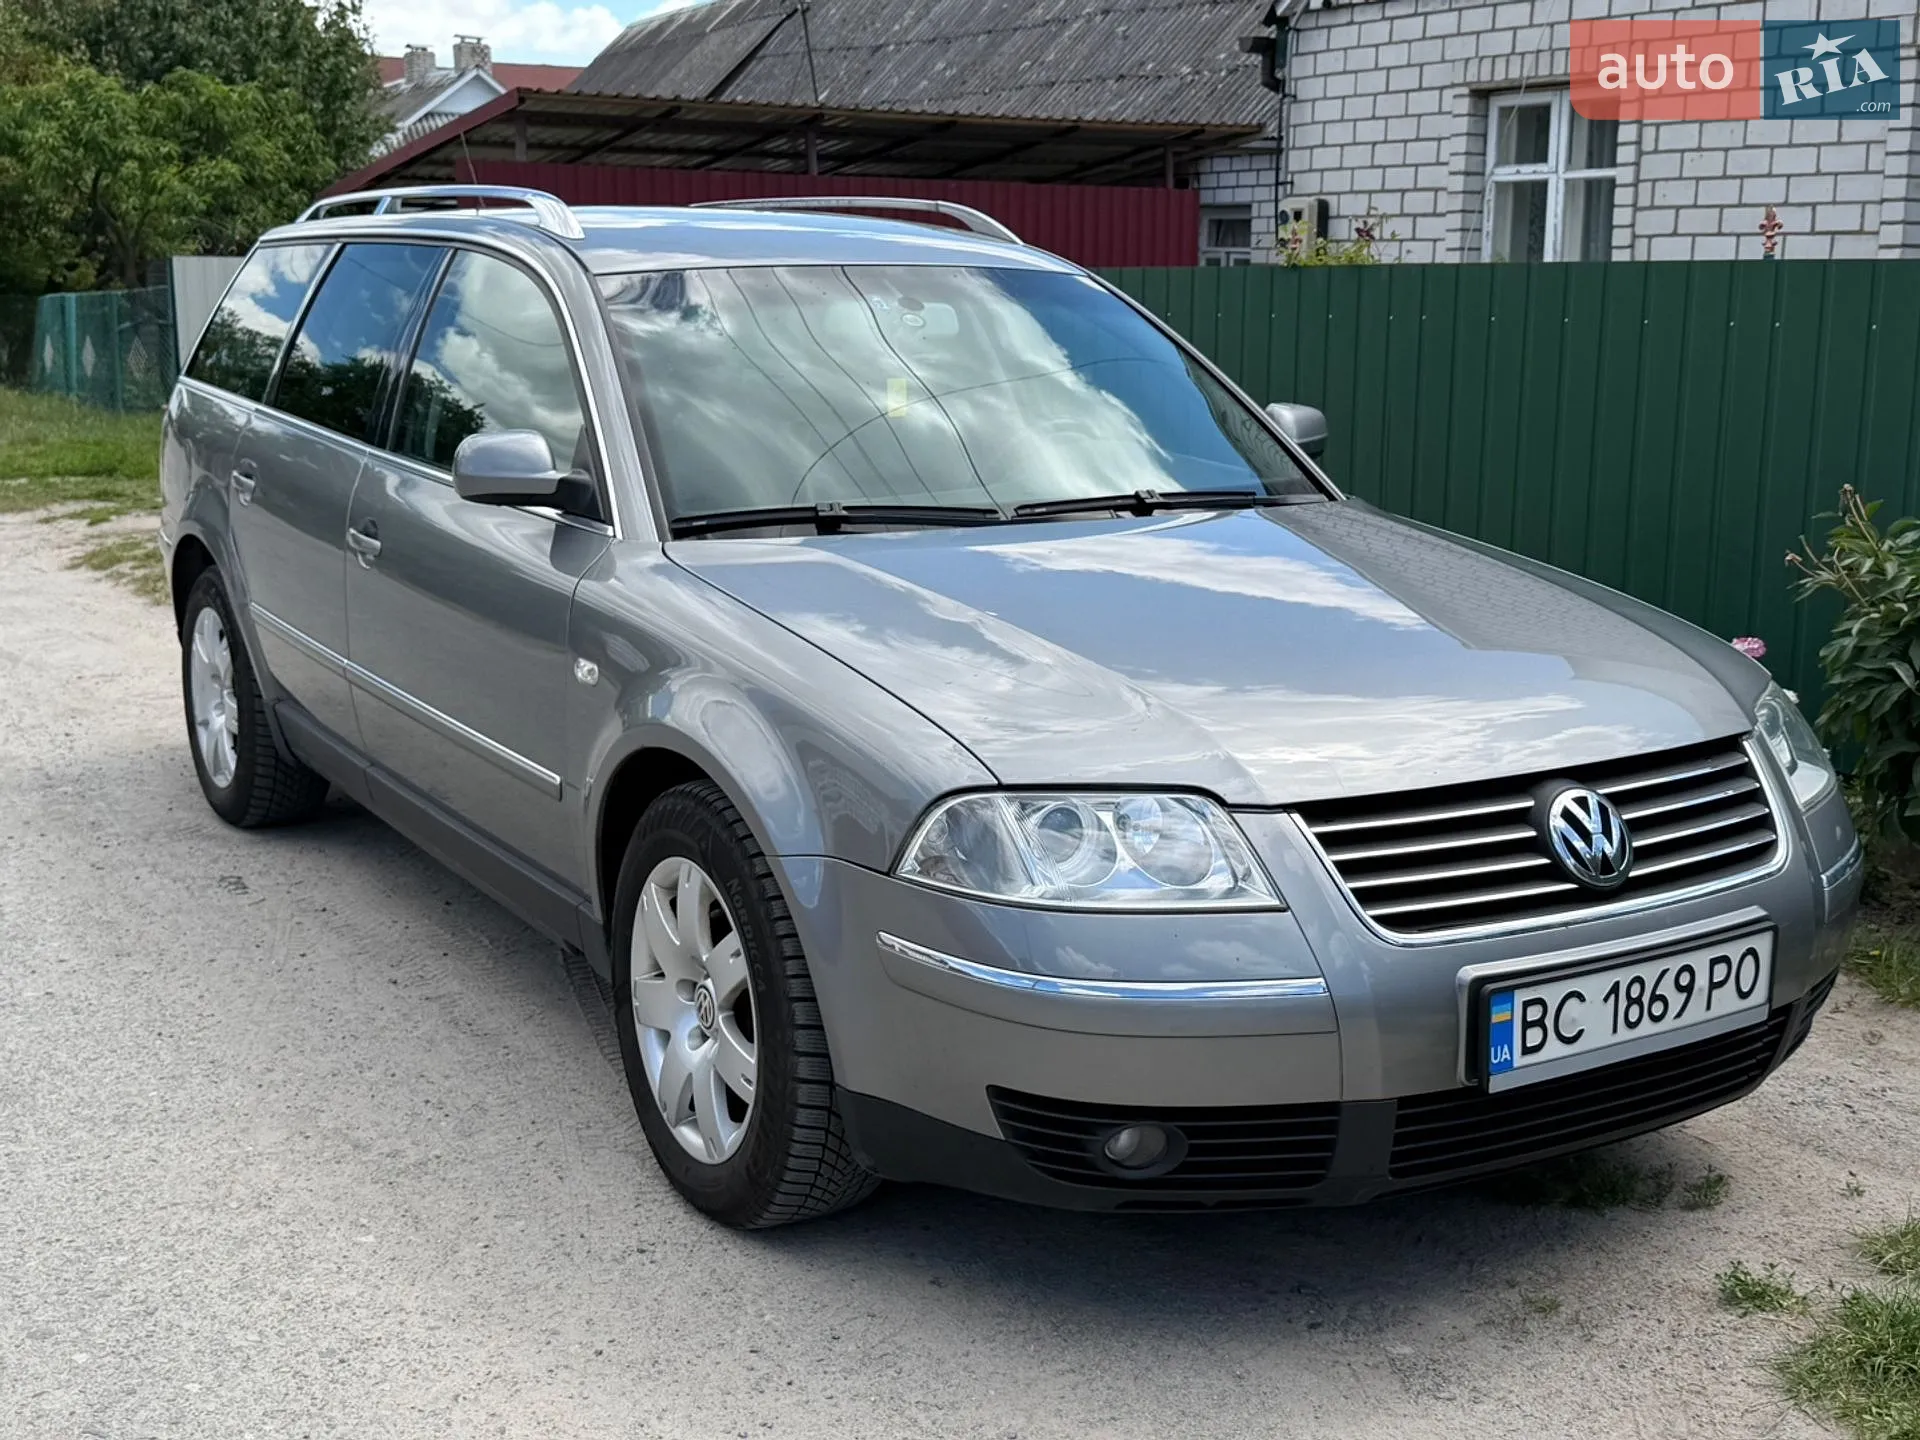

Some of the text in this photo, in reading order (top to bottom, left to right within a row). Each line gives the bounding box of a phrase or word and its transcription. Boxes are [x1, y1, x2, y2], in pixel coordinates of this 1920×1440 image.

[1520, 946, 1760, 1056] BC 1869 PO
[1490, 1046, 1511, 1065] UA
